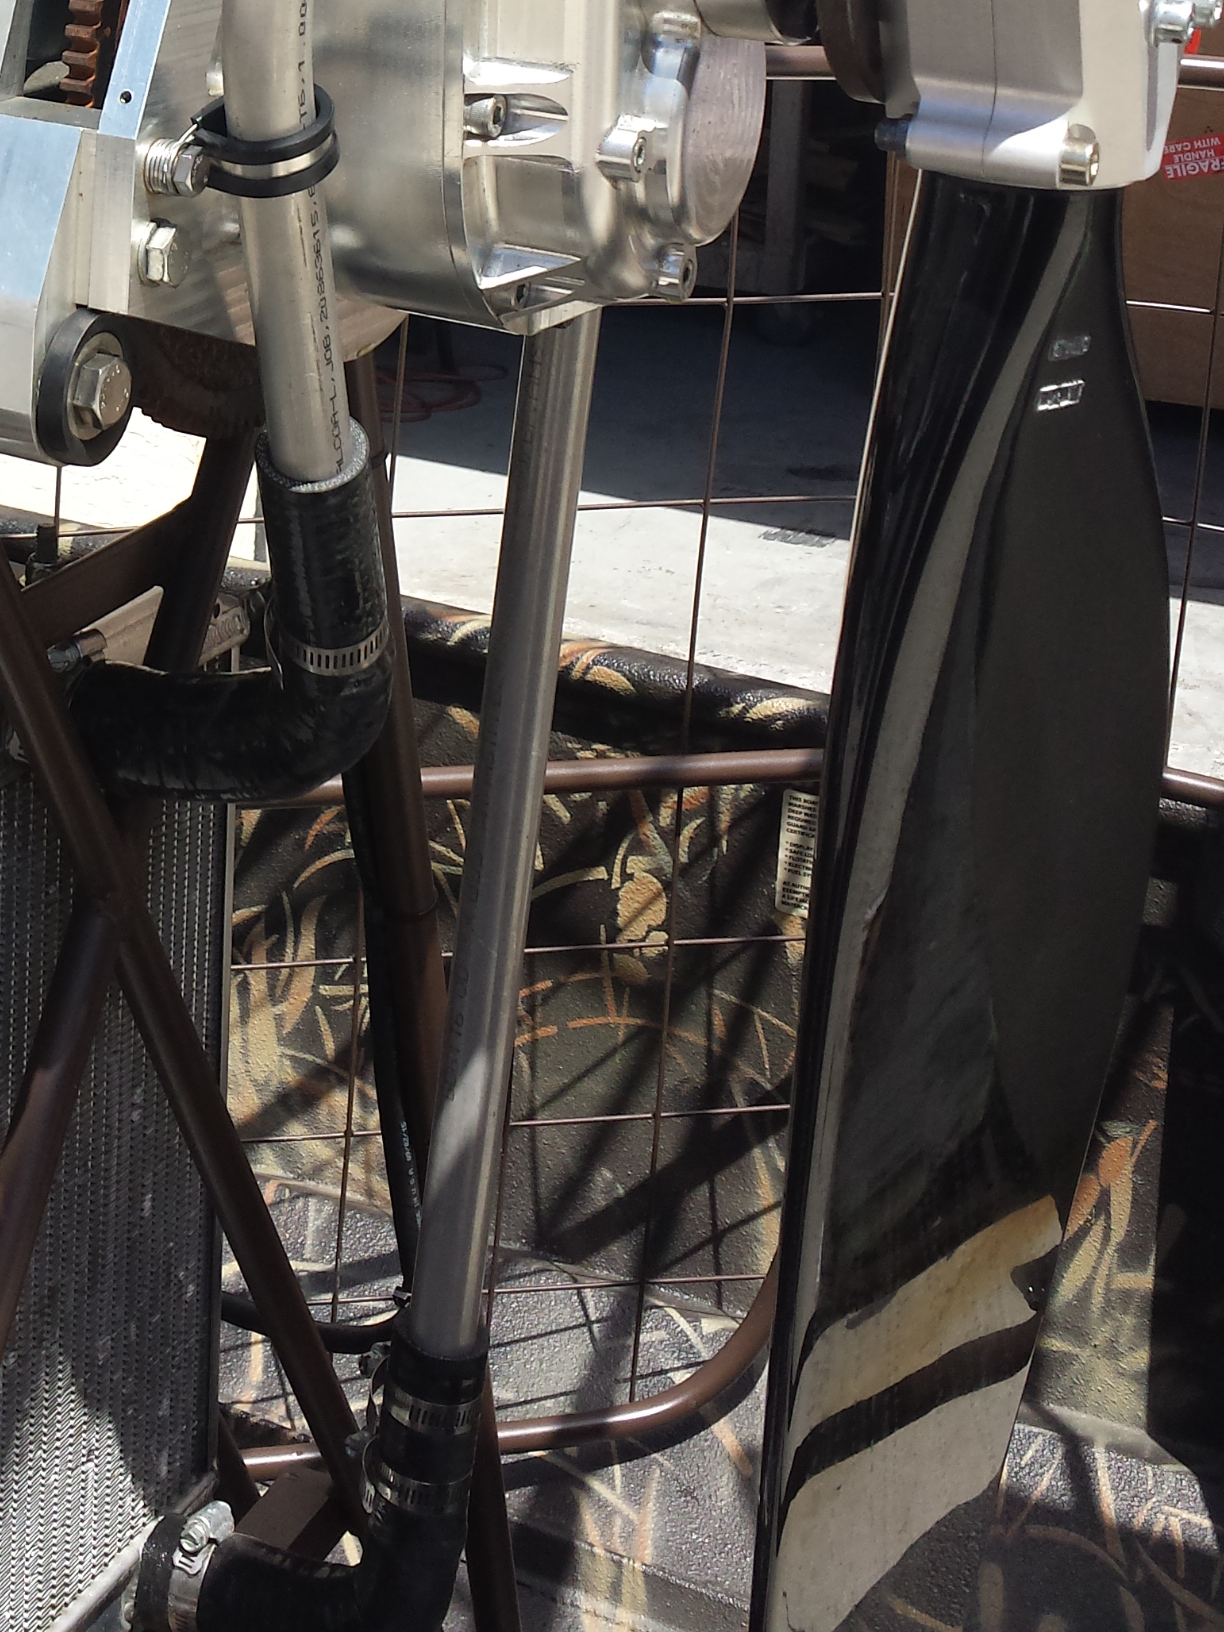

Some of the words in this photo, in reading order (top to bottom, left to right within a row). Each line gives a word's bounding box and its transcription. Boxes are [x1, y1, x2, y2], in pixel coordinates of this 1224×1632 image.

[1164, 142, 1191, 154] CARE
[1193, 137, 1221, 148] WITH
[1173, 149, 1215, 163] HANDLE
